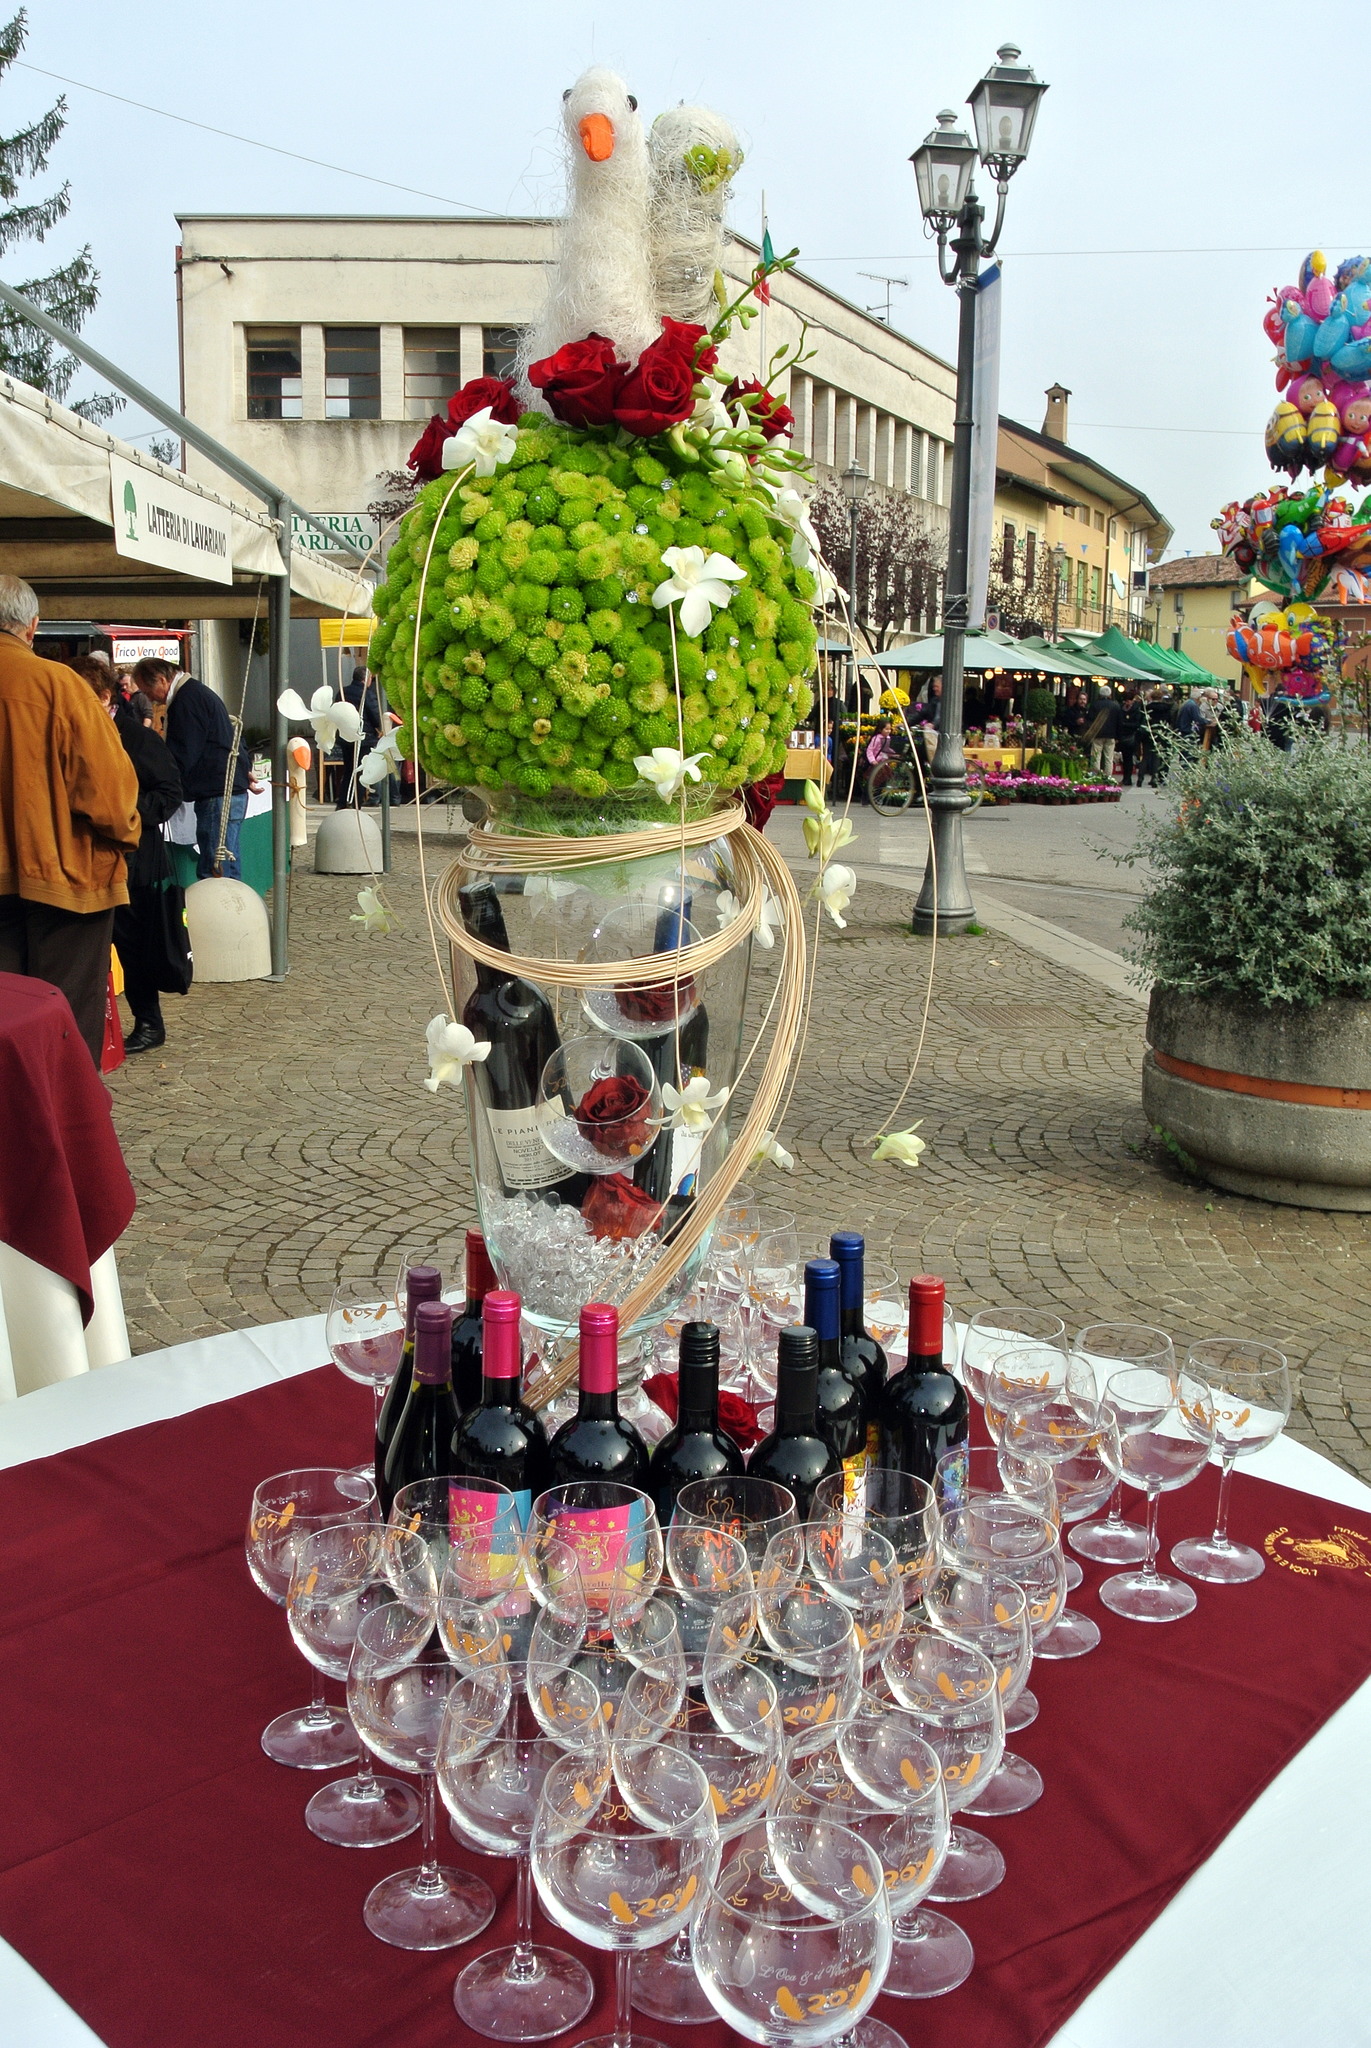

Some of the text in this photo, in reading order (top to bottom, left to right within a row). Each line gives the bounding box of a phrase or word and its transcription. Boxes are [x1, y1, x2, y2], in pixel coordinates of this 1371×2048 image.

[146, 502, 227, 558] LATTERIA DI LAVARIANO
[137, 646, 157, 658] Very
[637, 1887, 683, 1918] 20°
[758, 1964, 797, 1982] L'Oca
[799, 1969, 813, 1986] &
[813, 1968, 826, 1981] il
[825, 1962, 850, 1978] Vino
[807, 1983, 856, 2016] 20°
